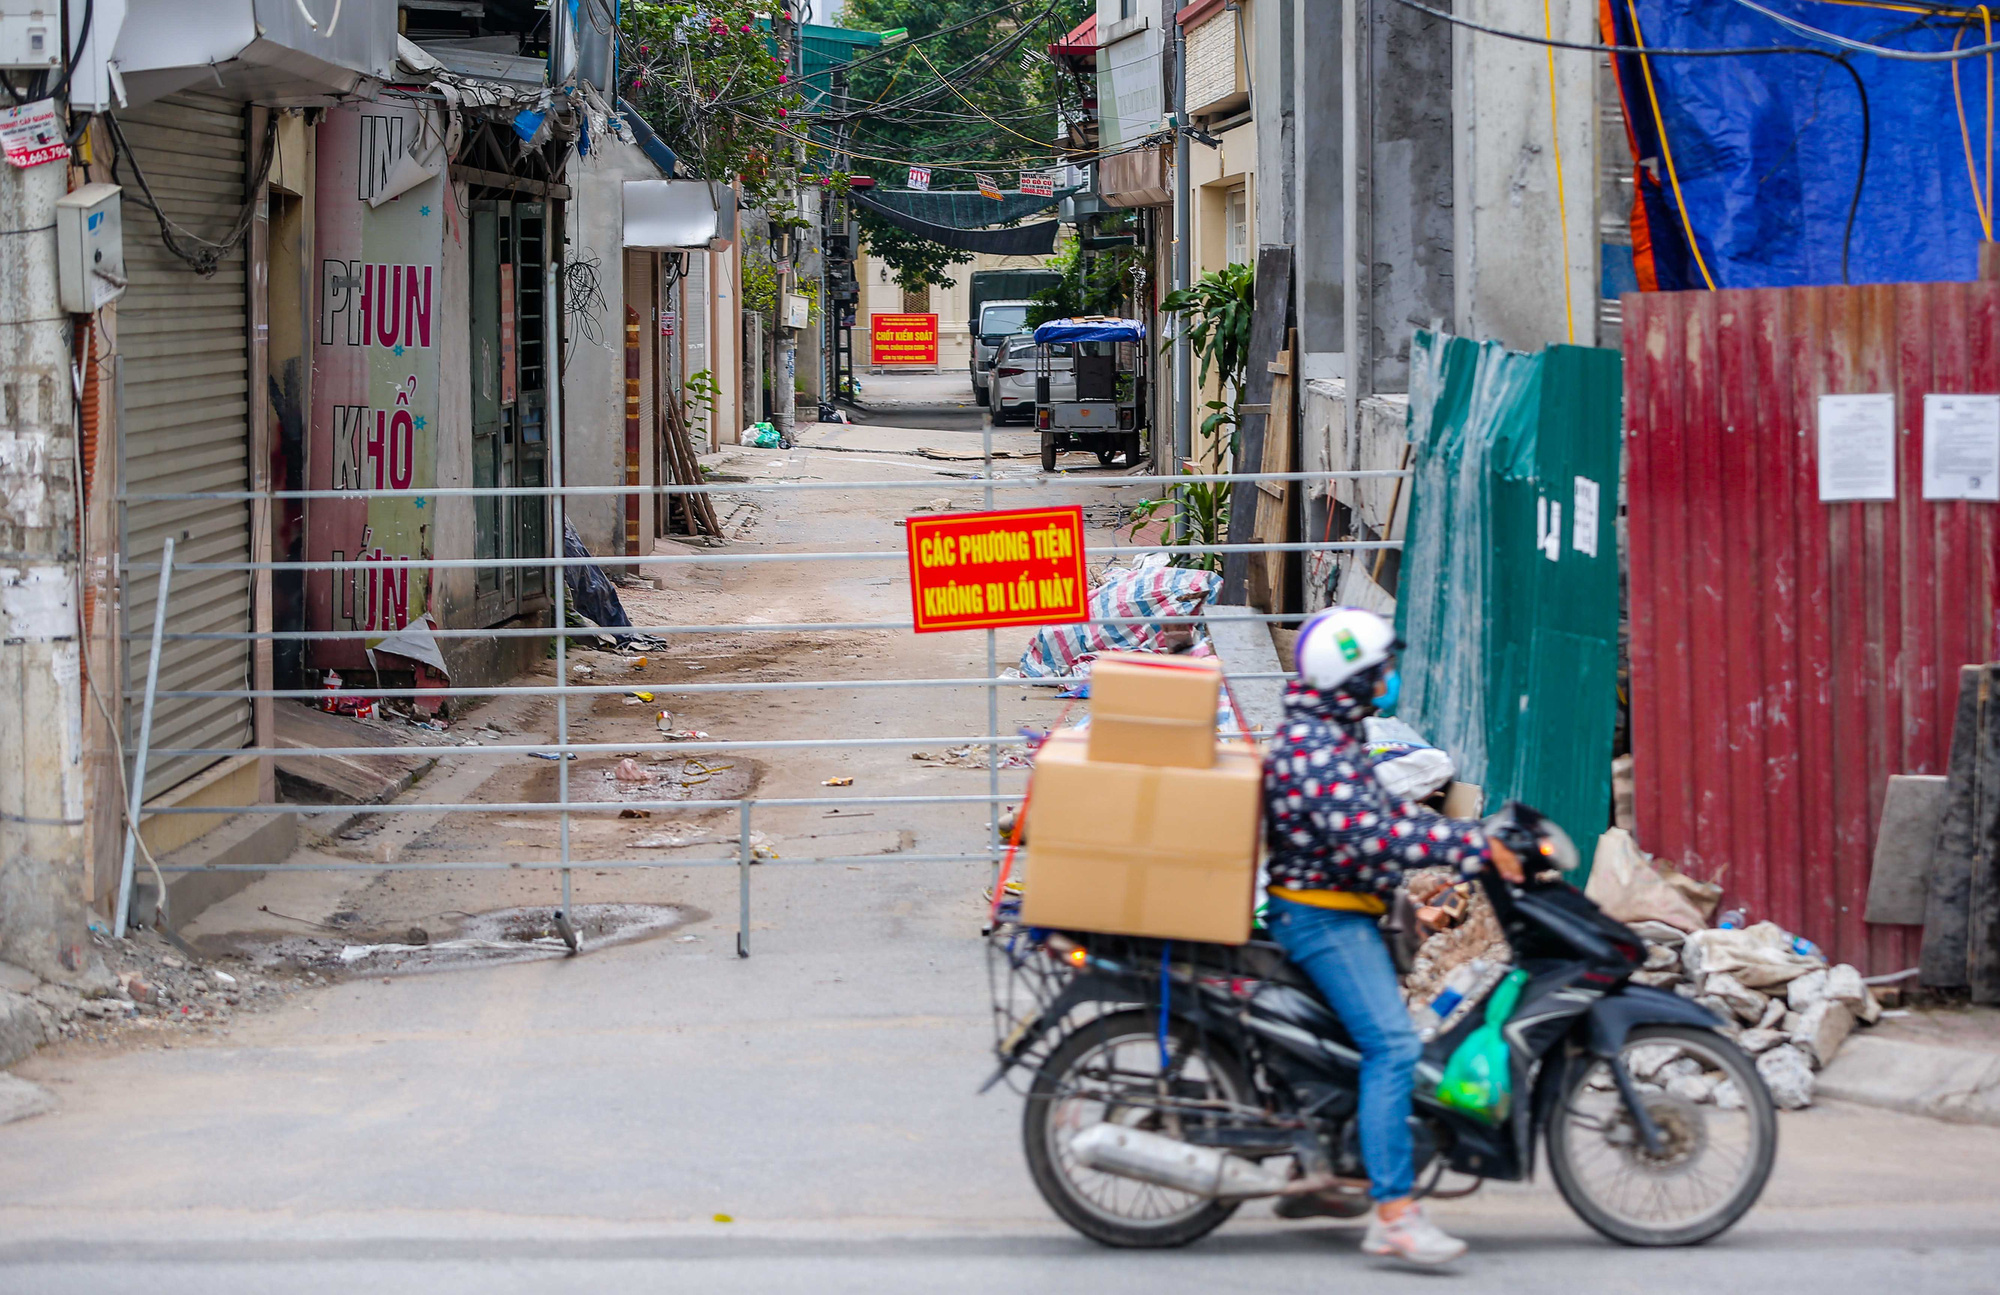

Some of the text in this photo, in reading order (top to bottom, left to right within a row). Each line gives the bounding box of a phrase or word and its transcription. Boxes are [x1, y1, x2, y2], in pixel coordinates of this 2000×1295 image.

[358, 115, 403, 200] IN
[321, 259, 432, 348] PHUN
[876, 328, 933, 341] CHỐT KIỂM SOÁT
[332, 374, 417, 491] KHỔ
[332, 524, 409, 637] LỚN
[920, 523, 1073, 568] CÁC PHƯƠNG TIỆN
[923, 570, 1074, 617] KHÔNG ĐI LỐI NÀY
